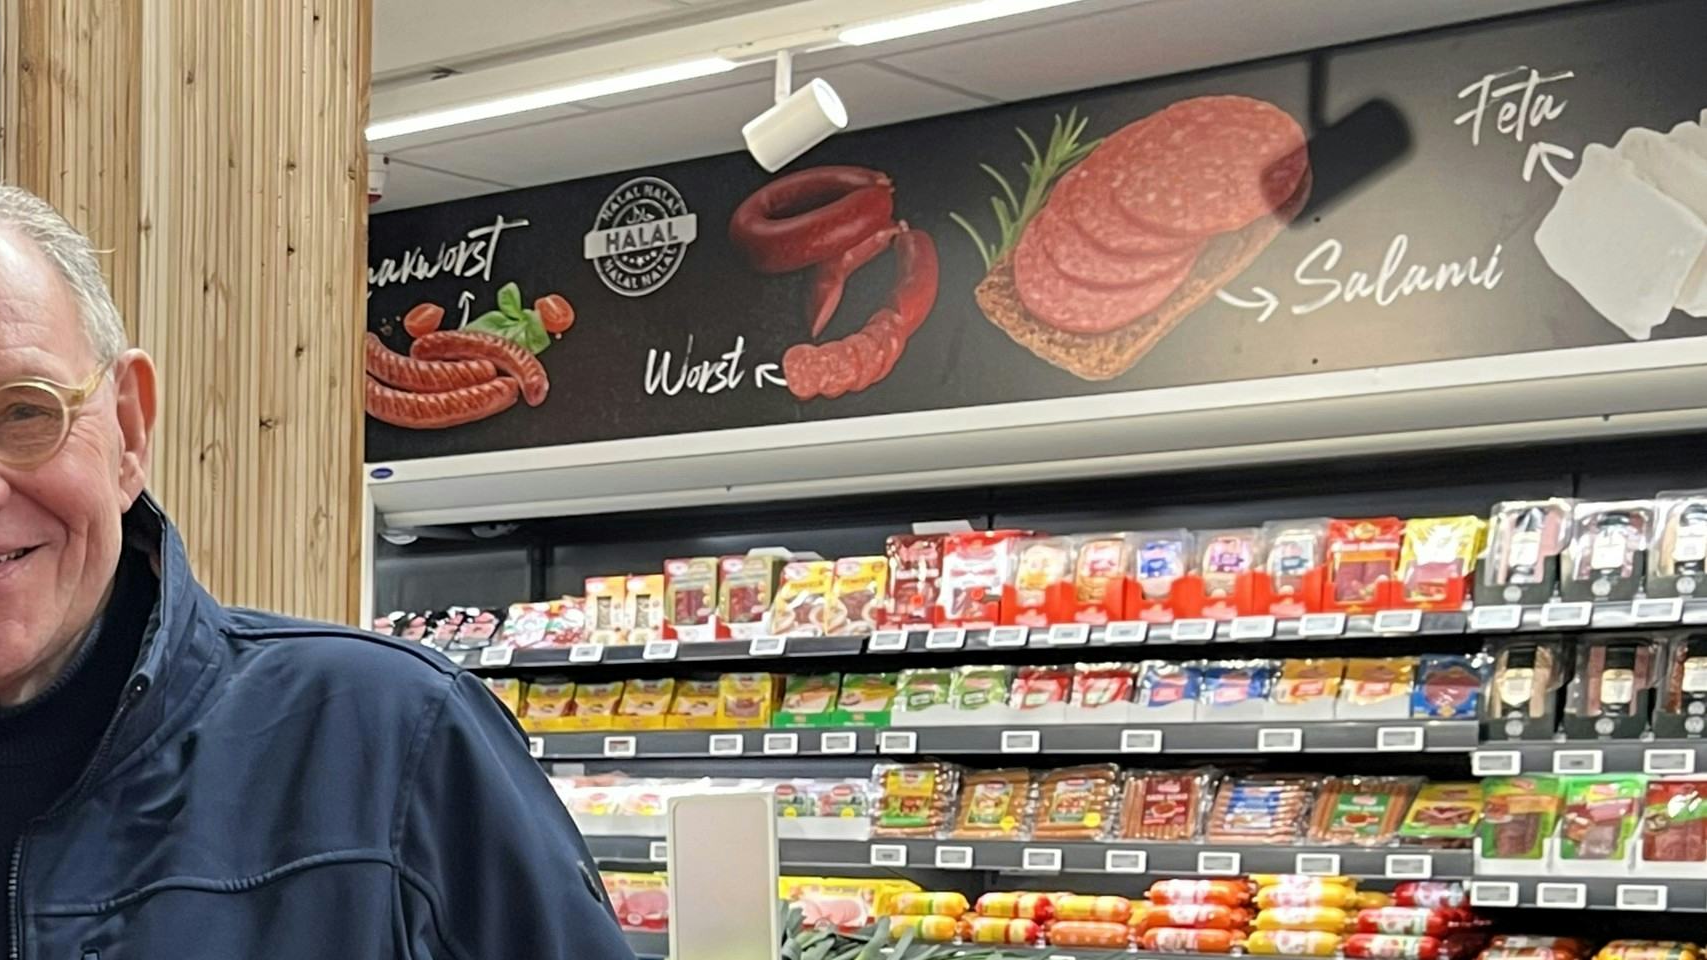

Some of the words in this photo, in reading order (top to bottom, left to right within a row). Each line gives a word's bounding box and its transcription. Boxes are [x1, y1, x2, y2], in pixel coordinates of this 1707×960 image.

[1454, 66, 1574, 146] Feta
[606, 221, 679, 255] HALAL
[1292, 234, 1504, 315] Salami
[644, 334, 746, 396] Worst
